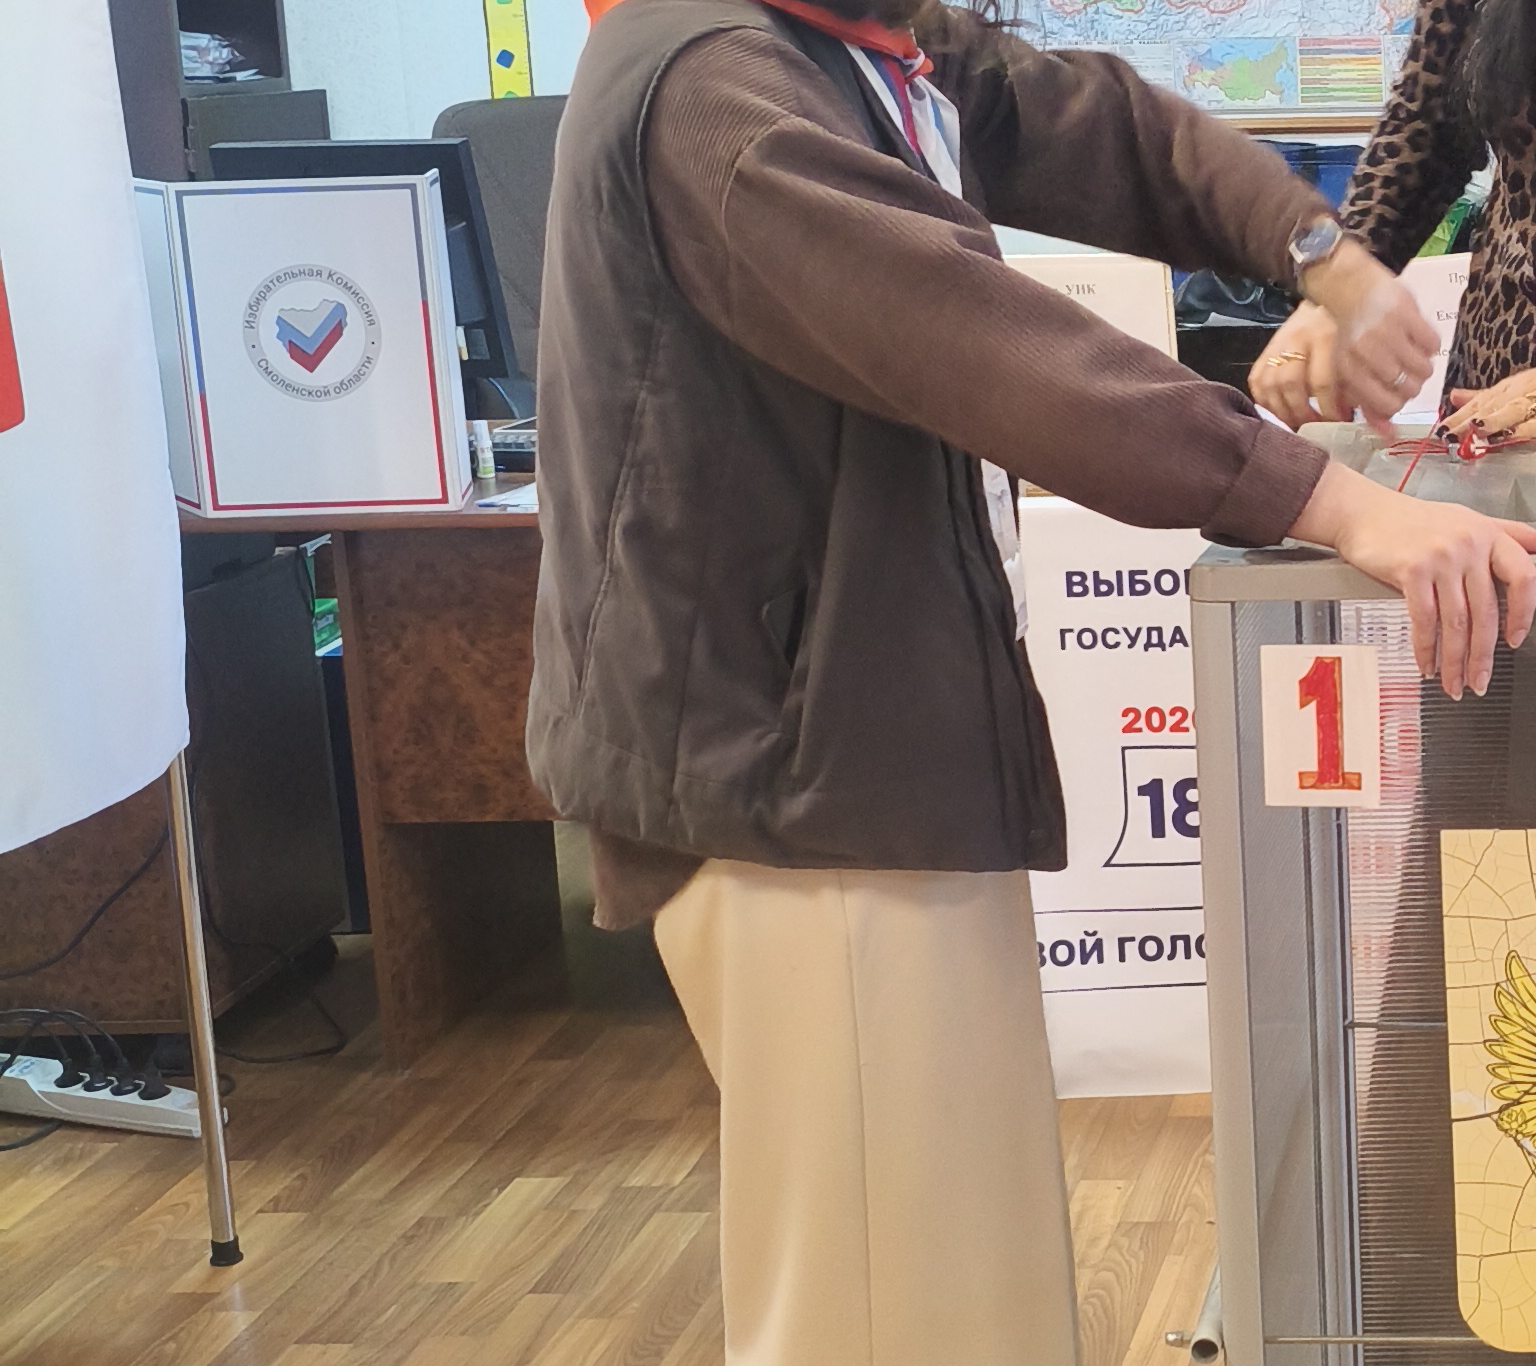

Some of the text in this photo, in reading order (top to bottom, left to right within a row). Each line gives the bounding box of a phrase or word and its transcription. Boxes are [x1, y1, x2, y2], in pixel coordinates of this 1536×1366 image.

[244, 267, 377, 330] Избирательная Комиссия
[257, 355, 375, 399] Смоленской области
[1065, 568, 1190, 598] ВЫБО
[1121, 705, 1196, 734] 202
[1298, 656, 1363, 790] 1
